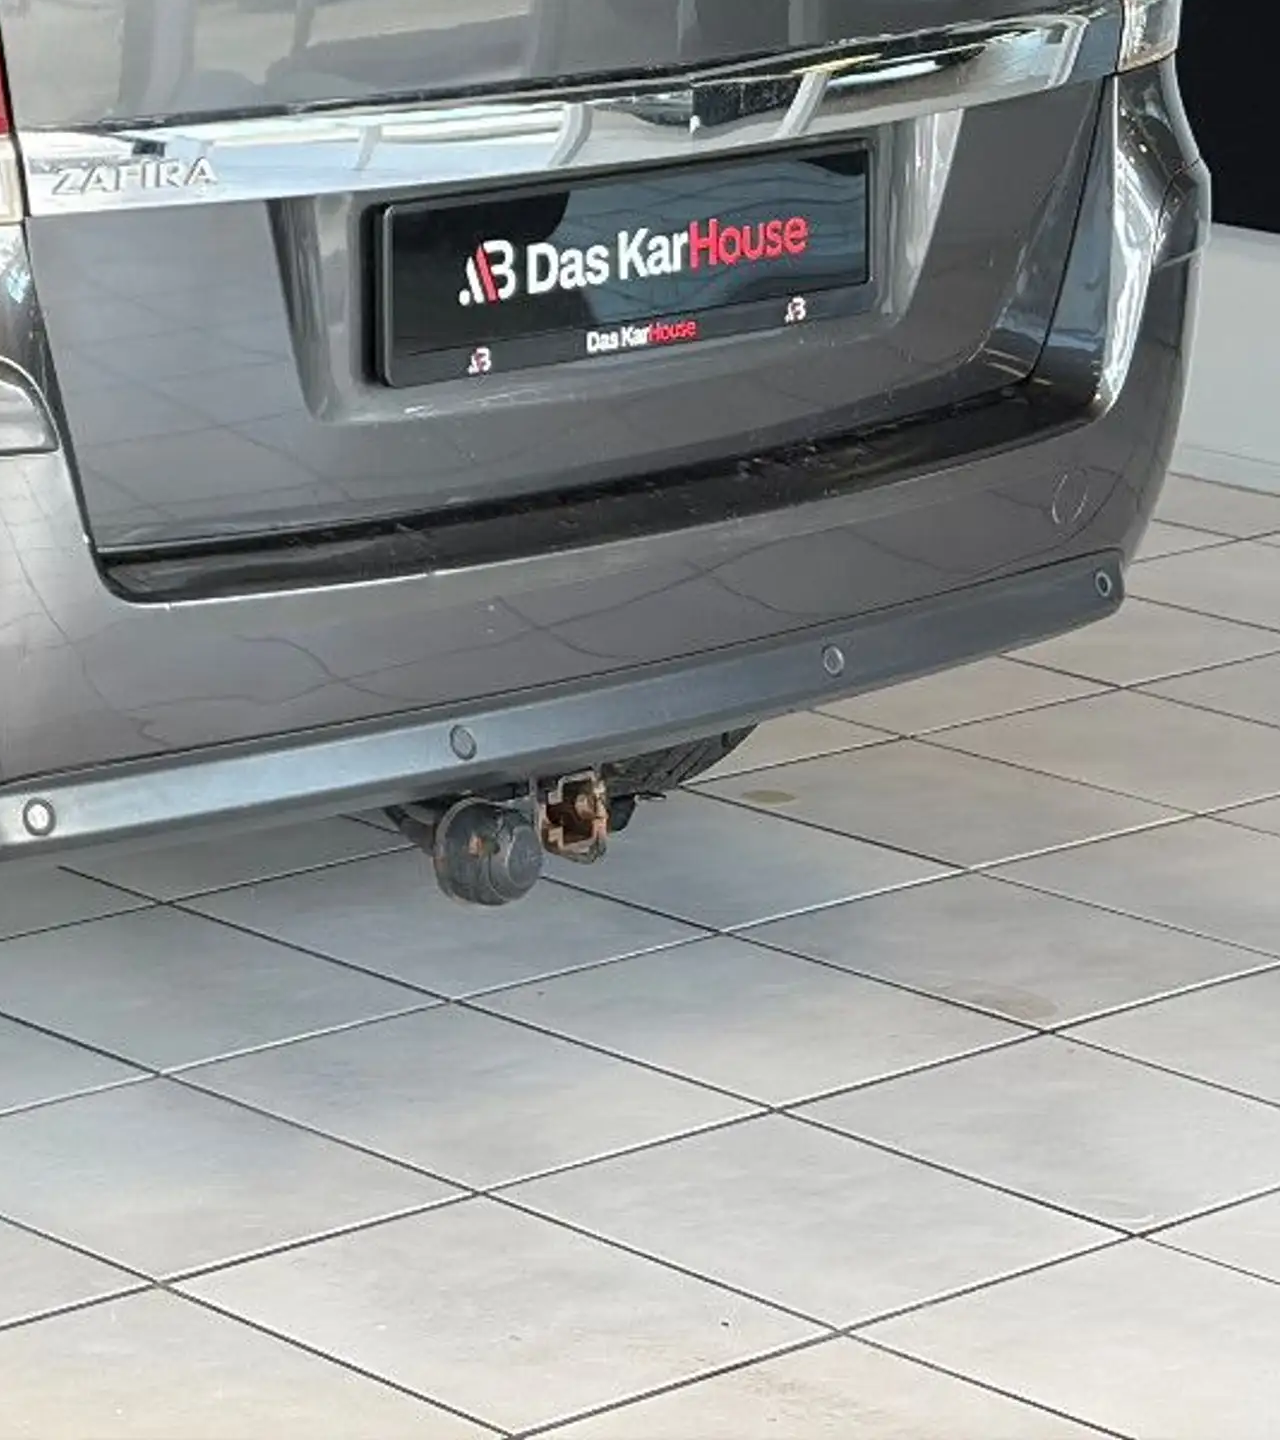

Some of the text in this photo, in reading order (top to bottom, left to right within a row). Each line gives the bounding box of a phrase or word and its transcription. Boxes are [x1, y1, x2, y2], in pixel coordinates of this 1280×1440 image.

[51, 156, 218, 196] ZAFIRA
[526, 243, 610, 295] Das
[618, 216, 809, 281] KarHouse
[586, 319, 698, 353] Das KarHouse
